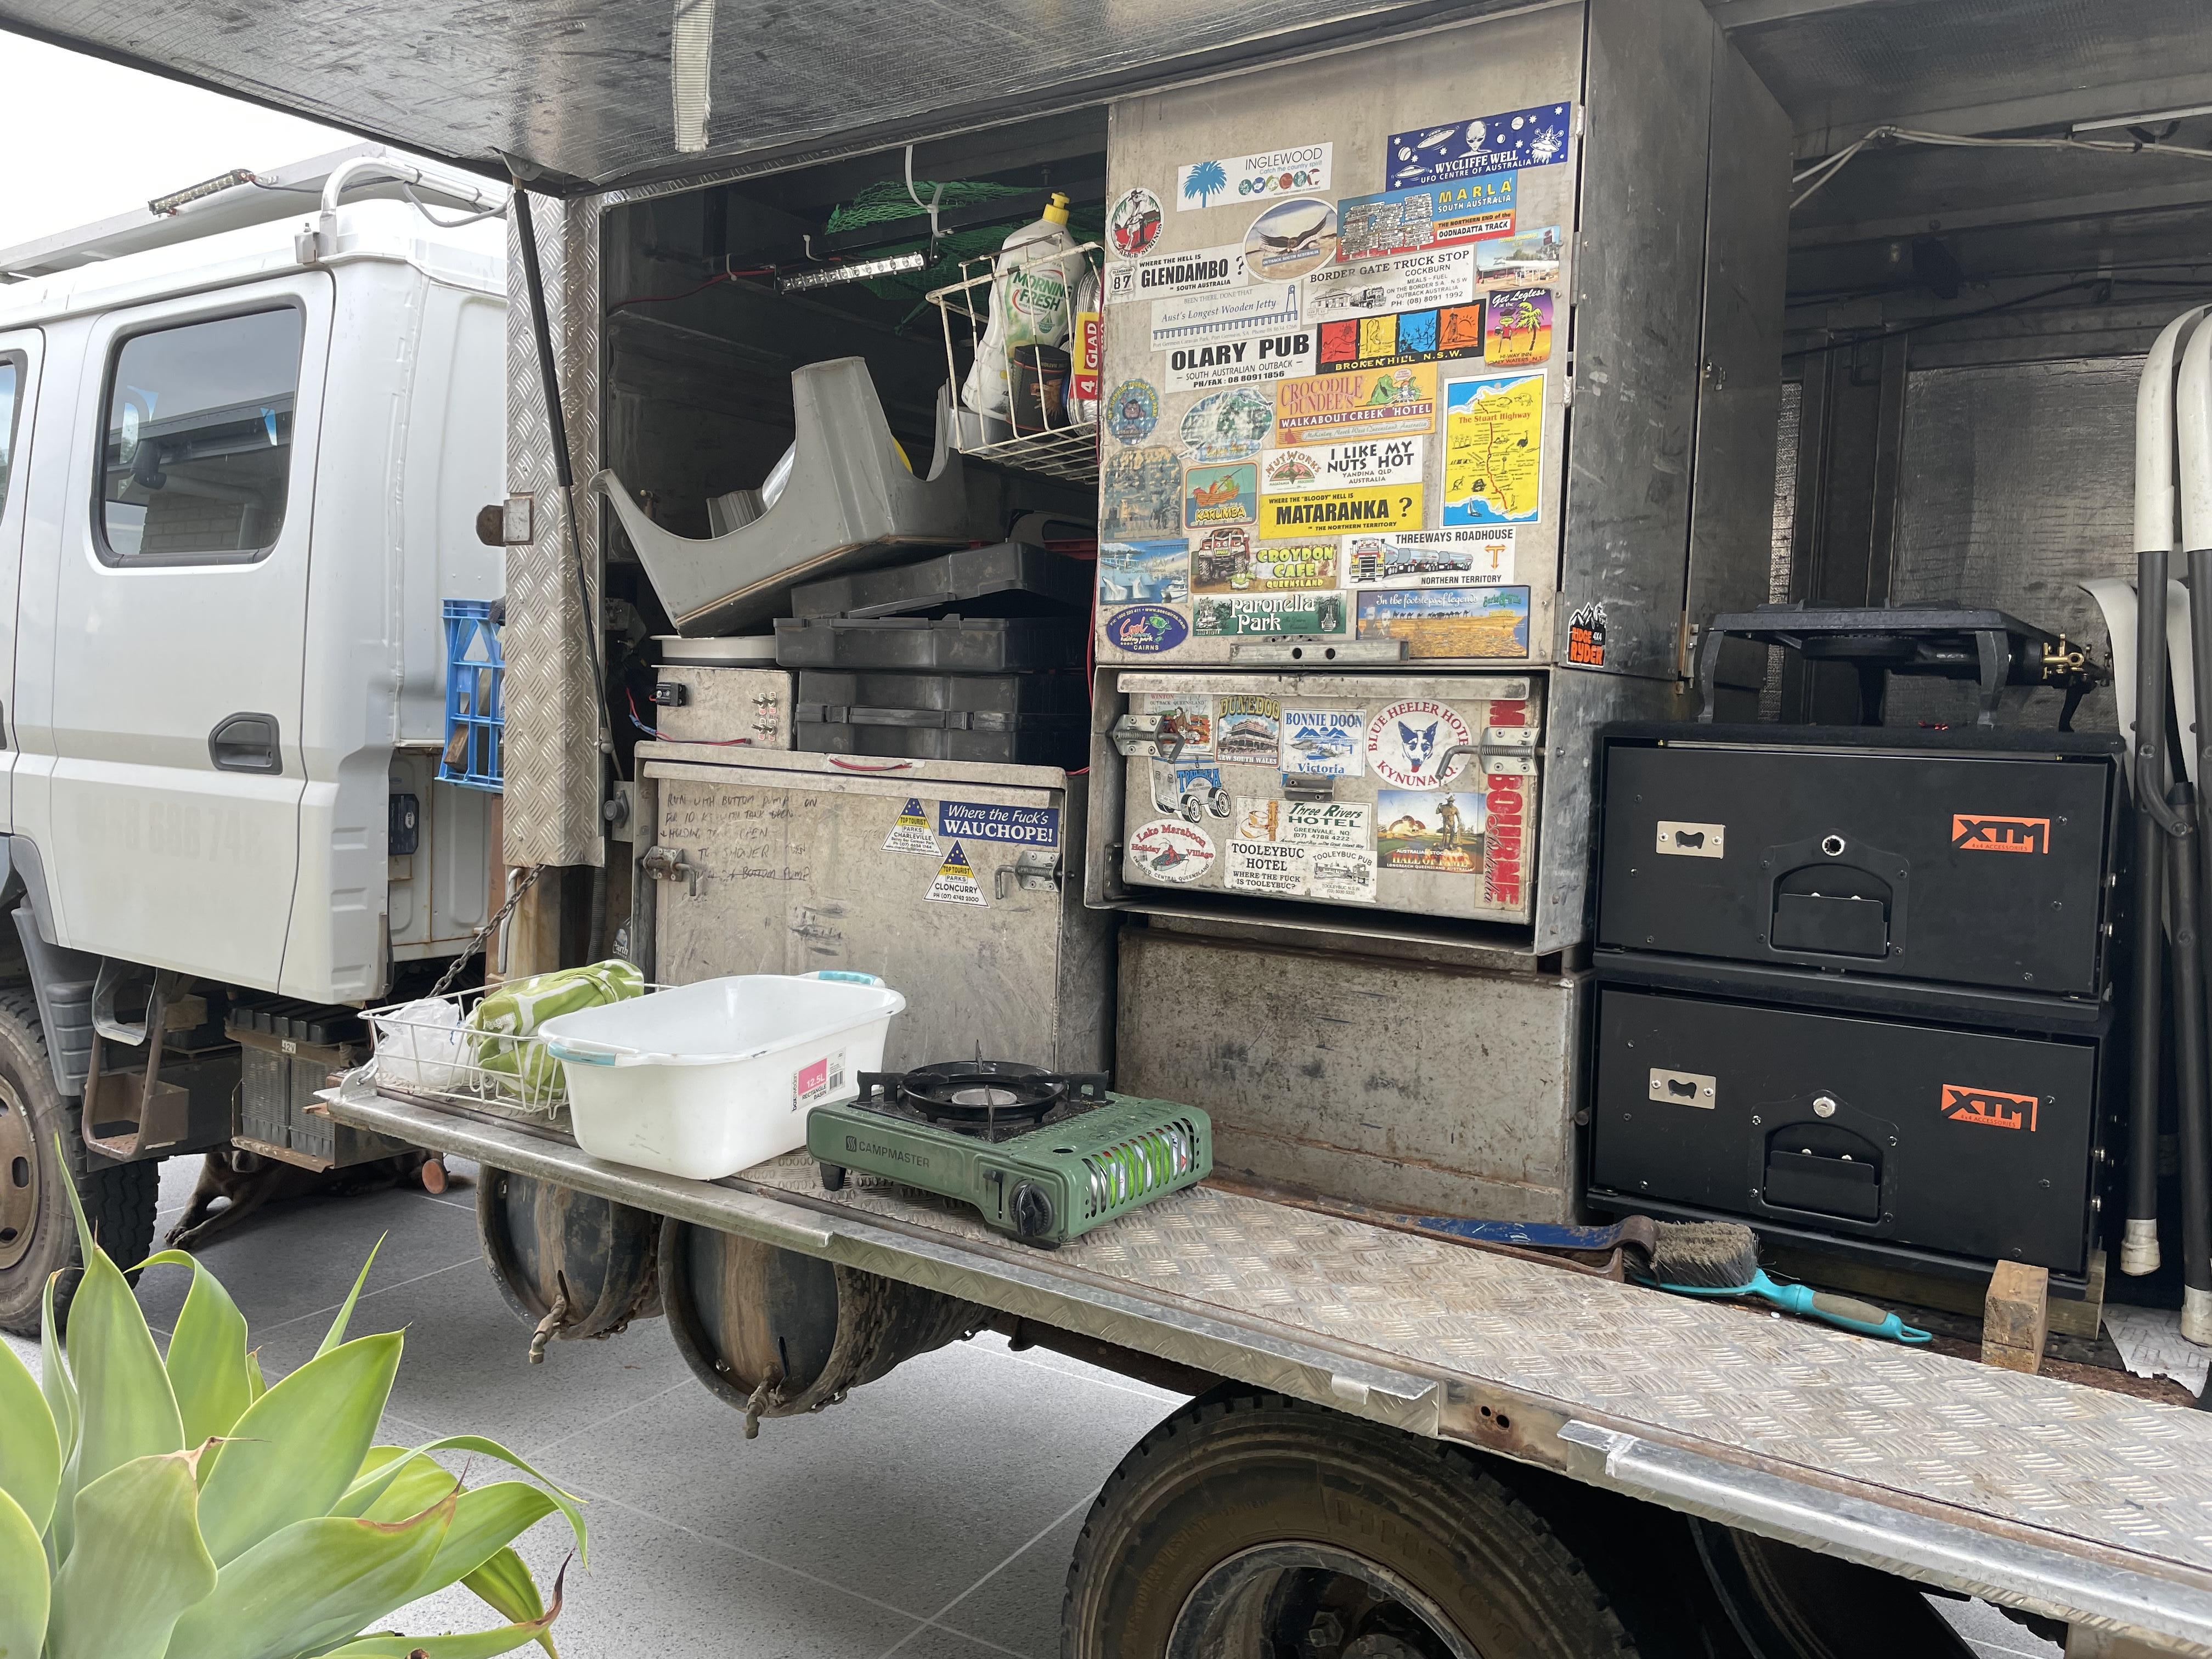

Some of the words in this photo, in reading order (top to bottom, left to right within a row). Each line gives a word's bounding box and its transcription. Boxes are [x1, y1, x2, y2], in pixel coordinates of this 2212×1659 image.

[1245, 148, 1322, 170] INGLEWOOD
[1435, 156, 1488, 174] WYCLIFFE
[1490, 150, 1518, 164] WELL
[1421, 175, 1436, 183] UFO
[1440, 168, 1470, 180] CENTRE
[1486, 159, 1531, 172] AUSTRALIA
[1438, 202, 1464, 213] SOUTH
[1466, 195, 1511, 208] AUSTRALIA
[1450, 216, 1480, 226] NORTHERN
[1439, 225, 1482, 238] OODNADATTA
[1485, 221, 1508, 231] TRACK
[1359, 263, 1390, 275] GATE
[1393, 257, 1434, 270] TRUCK
[1438, 251, 1469, 262] STOP
[1405, 264, 1451, 276] COCKBURN
[1141, 258, 1228, 288] GLENDAMBO
[1013, 272, 1073, 298] MORNING
[1114, 274, 1131, 290] 87
[1198, 279, 1231, 289] AUSTRALIA
[1020, 289, 1060, 312] FRESH
[1407, 297, 1421, 306] (08)
[1424, 295, 1442, 303] 8091
[1492, 295, 1509, 307] Get
[1510, 288, 1546, 302] Legless
[1188, 307, 1219, 319] Longest
[1222, 304, 1254, 314] Wooden
[1256, 300, 1277, 311] Jetty
[1086, 323, 1098, 369] GLAD
[1172, 342, 1247, 370] OLARY
[1260, 334, 1309, 359] PUB
[1186, 372, 1209, 380] SOUTH
[1212, 365, 1255, 377] AUSTRALIAN
[1259, 360, 1292, 371] OUTBACK
[1335, 358, 1385, 371] BROKEN
[1387, 356, 1415, 365] HILL
[1081, 380, 1095, 393] 4
[1281, 375, 1363, 407] CROCODILE
[1282, 413, 1347, 427] WALKABOUT
[1500, 411, 1531, 420] Highway
[1331, 449, 1335, 460] I
[1345, 444, 1377, 458] LIKE
[1385, 441, 1412, 454] MY
[1328, 458, 1367, 473] NUTS
[1378, 453, 1414, 466] HOT
[1196, 506, 1246, 521] KARUMBA
[1276, 499, 1389, 525] MATARANKA
[1399, 498, 1412, 517] ?
[1396, 532, 1452, 544] THREEWAYS
[1455, 529, 1513, 541] ROADHOUSE
[1257, 546, 1334, 562] CROYDON
[1273, 563, 1316, 578] CAFE
[1266, 579, 1324, 588] QUEENSLAND
[1421, 577, 1459, 585] NORTHERN
[1462, 575, 1502, 583] TERRITORY
[1230, 594, 1315, 618] Paronella
[1390, 595, 1402, 605] the
[1404, 592, 1436, 608] footsteps
[1237, 613, 1282, 634] Park
[1571, 641, 1602, 665] RYDER
[1219, 695, 1280, 721] DUNEDOO
[1286, 713, 1326, 725] BONNIE
[1330, 714, 1363, 727] DOON
[1368, 715, 1387, 752] BLUE
[1387, 702, 1439, 719] HEELER
[1298, 763, 1344, 774] Victoria
[1376, 760, 1438, 786] KYNUNA
[668, 794, 686, 806] RUN
[721, 795, 754, 805] BOTTOM
[949, 805, 986, 819] Where
[989, 809, 1008, 821] the
[1013, 810, 1048, 824] Fuck's
[1289, 803, 1321, 815] Three
[1323, 805, 1363, 818] Rivers
[1288, 816, 1361, 827] HOTEL
[894, 832, 932, 840] CHARLEVILLE
[944, 819, 1053, 842] WAUCHOPE!
[1136, 828, 1159, 843] Lake
[1161, 825, 1205, 848] Maraboon
[1953, 819, 2044, 850] XTM
[1131, 844, 1161, 854] Holiday
[1186, 849, 1214, 859] Village
[1232, 843, 1305, 858] TOOLEYBUC
[1985, 843, 2028, 851] ACCESSORIES
[1246, 858, 1287, 871] HOTEL
[1313, 851, 1356, 861] TOOLEYBUC
[1358, 855, 1372, 866] PUB
[1154, 873, 1177, 881] CENTRAL
[1246, 880, 1296, 889] TOOLEYBUC?
[935, 883, 978, 894] CLONCURRY
[806, 1074, 825, 1088] 12.5L
[802, 1084, 826, 1100] RECTANGLE
[814, 1090, 826, 1099] BASIN
[1942, 1088, 2033, 1122] XTM
[1973, 1116, 2016, 1128] ACCESSORIES
[859, 1142, 930, 1168] CAMPMASTER
